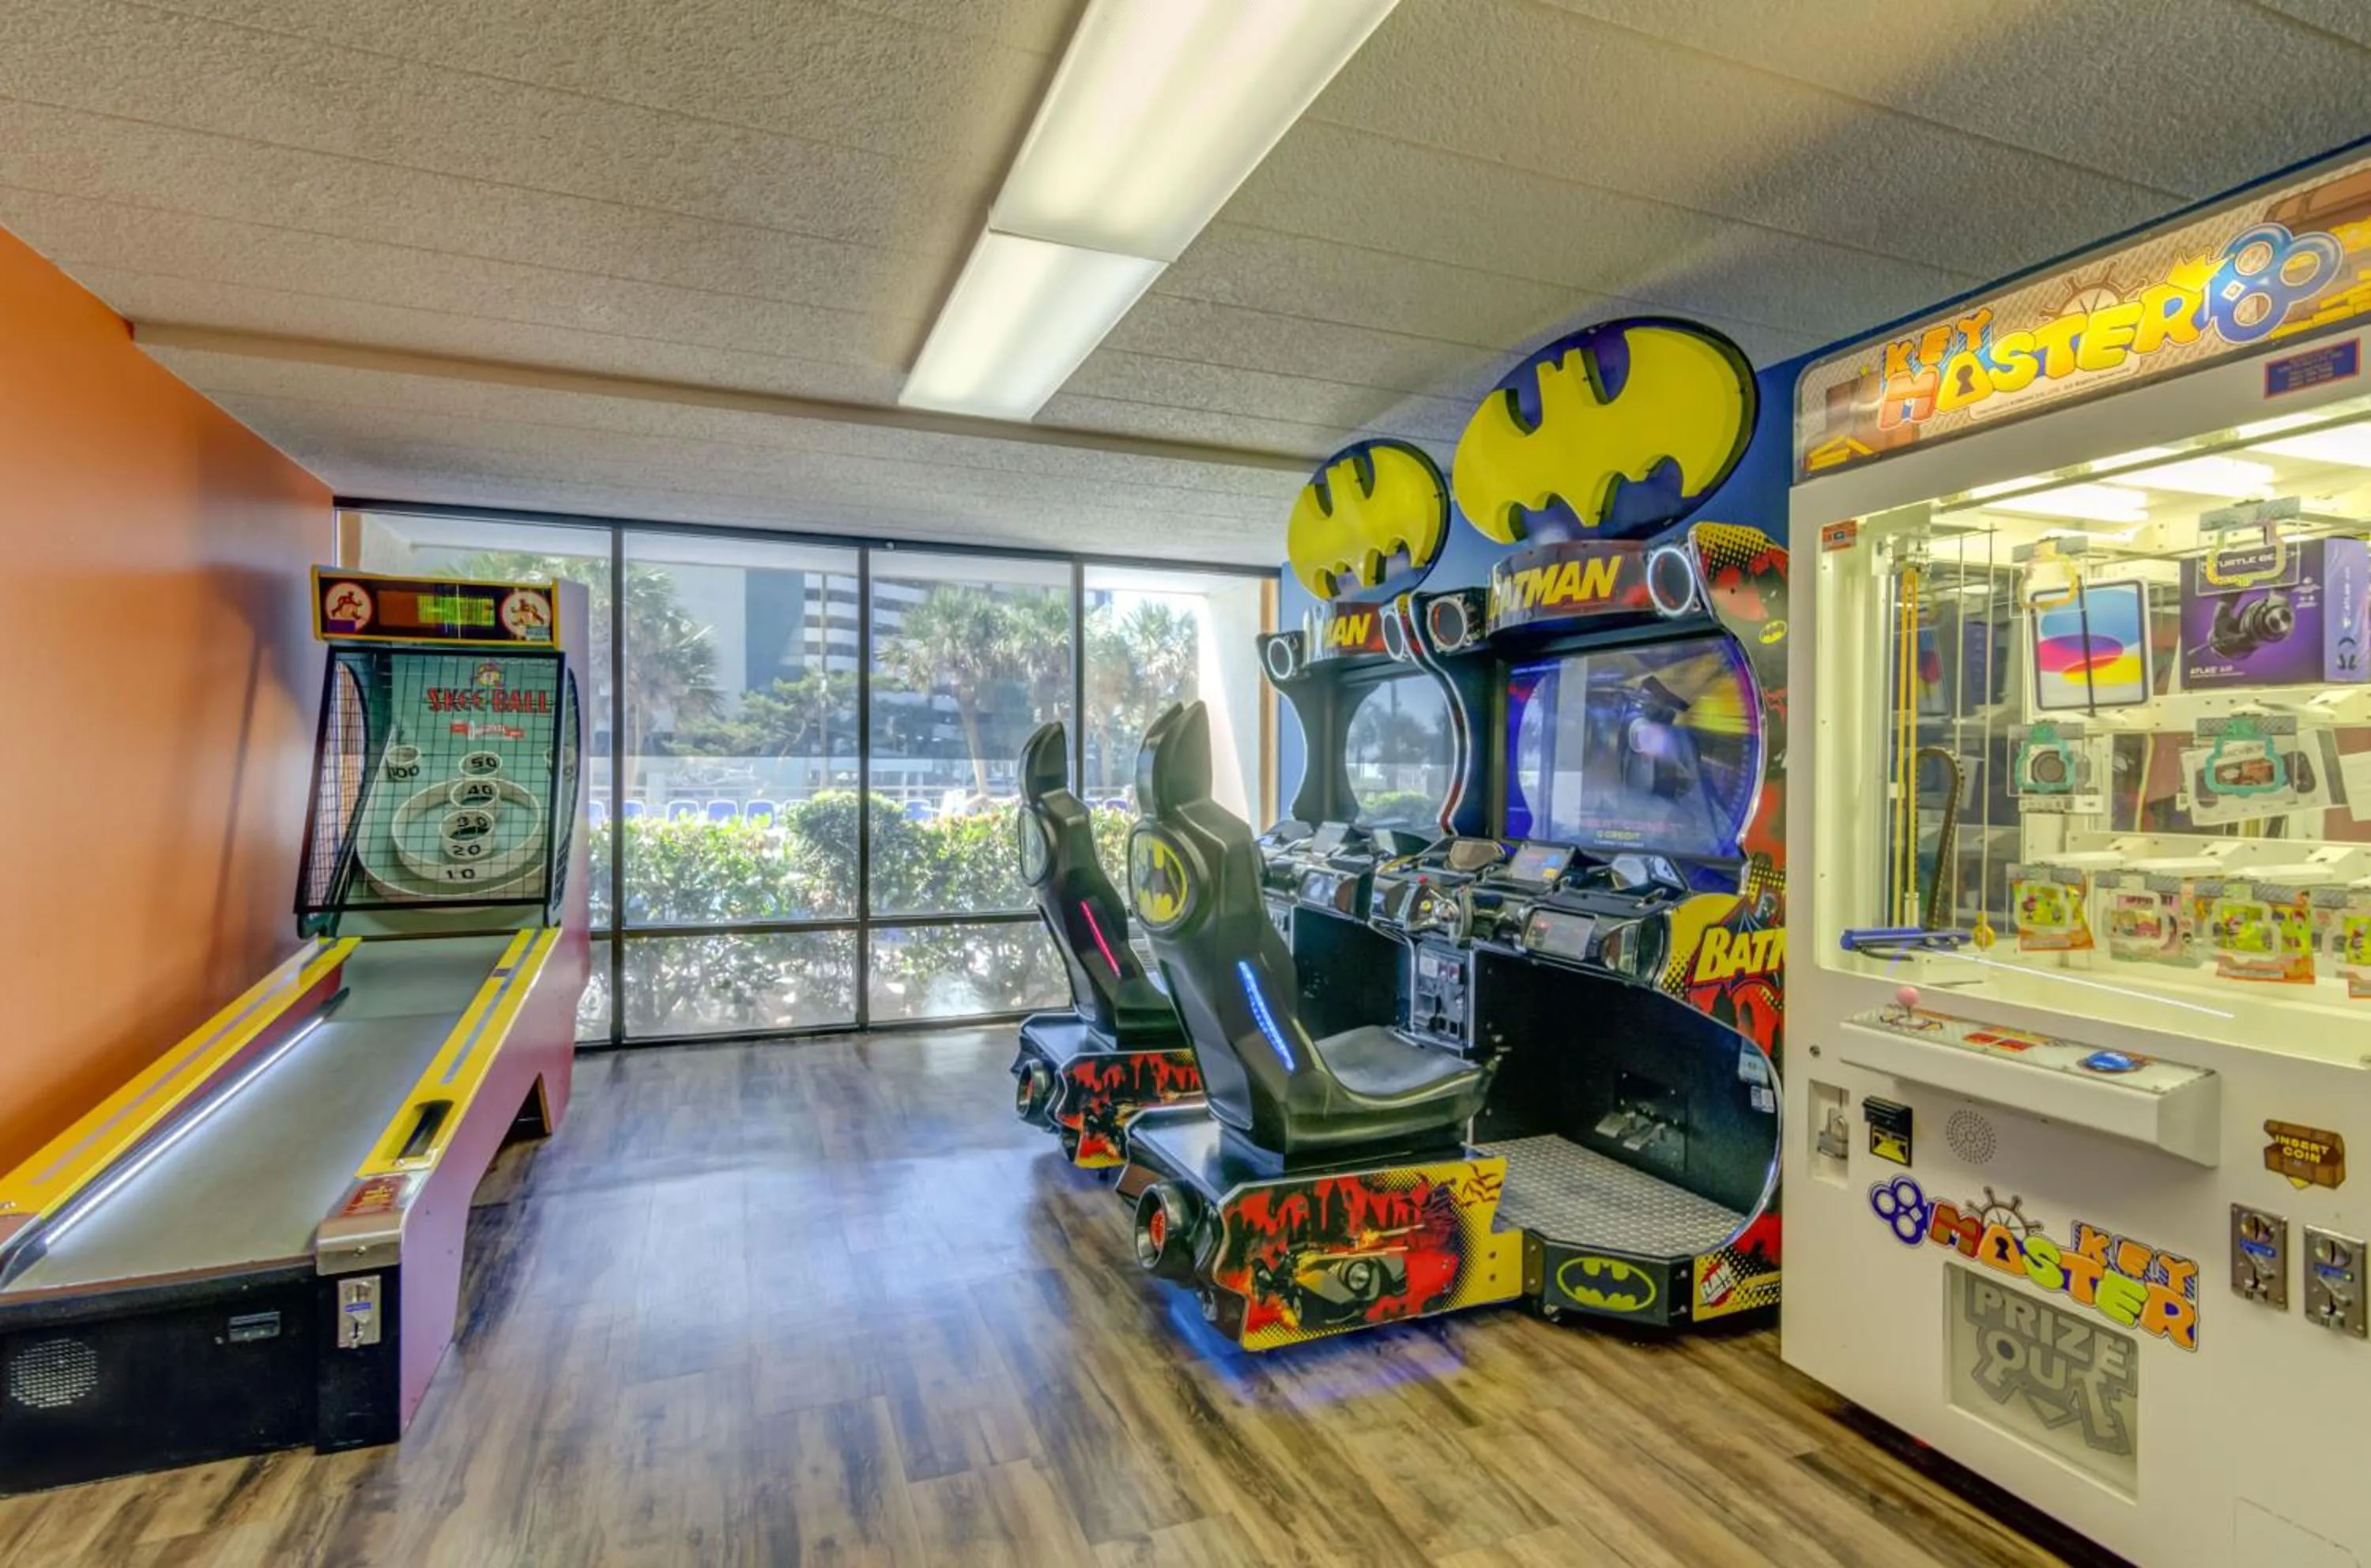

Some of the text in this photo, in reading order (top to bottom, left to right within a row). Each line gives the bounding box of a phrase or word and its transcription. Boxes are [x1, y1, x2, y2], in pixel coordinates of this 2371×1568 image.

[1885, 308, 1993, 379] KEY
[1879, 283, 2203, 429] MASTER
[471, 756, 497, 767] 50
[467, 785, 493, 795] 40
[457, 816, 488, 828] 30
[452, 844, 481, 856] 20
[447, 869, 475, 880] 10
[2275, 1134, 2330, 1155] INSERT
[2282, 1147, 2321, 1163] COIN
[2079, 1226, 2197, 1294] KEY
[1929, 1201, 2196, 1350] MASTER
[1975, 1280, 2128, 1380] PRIZE
